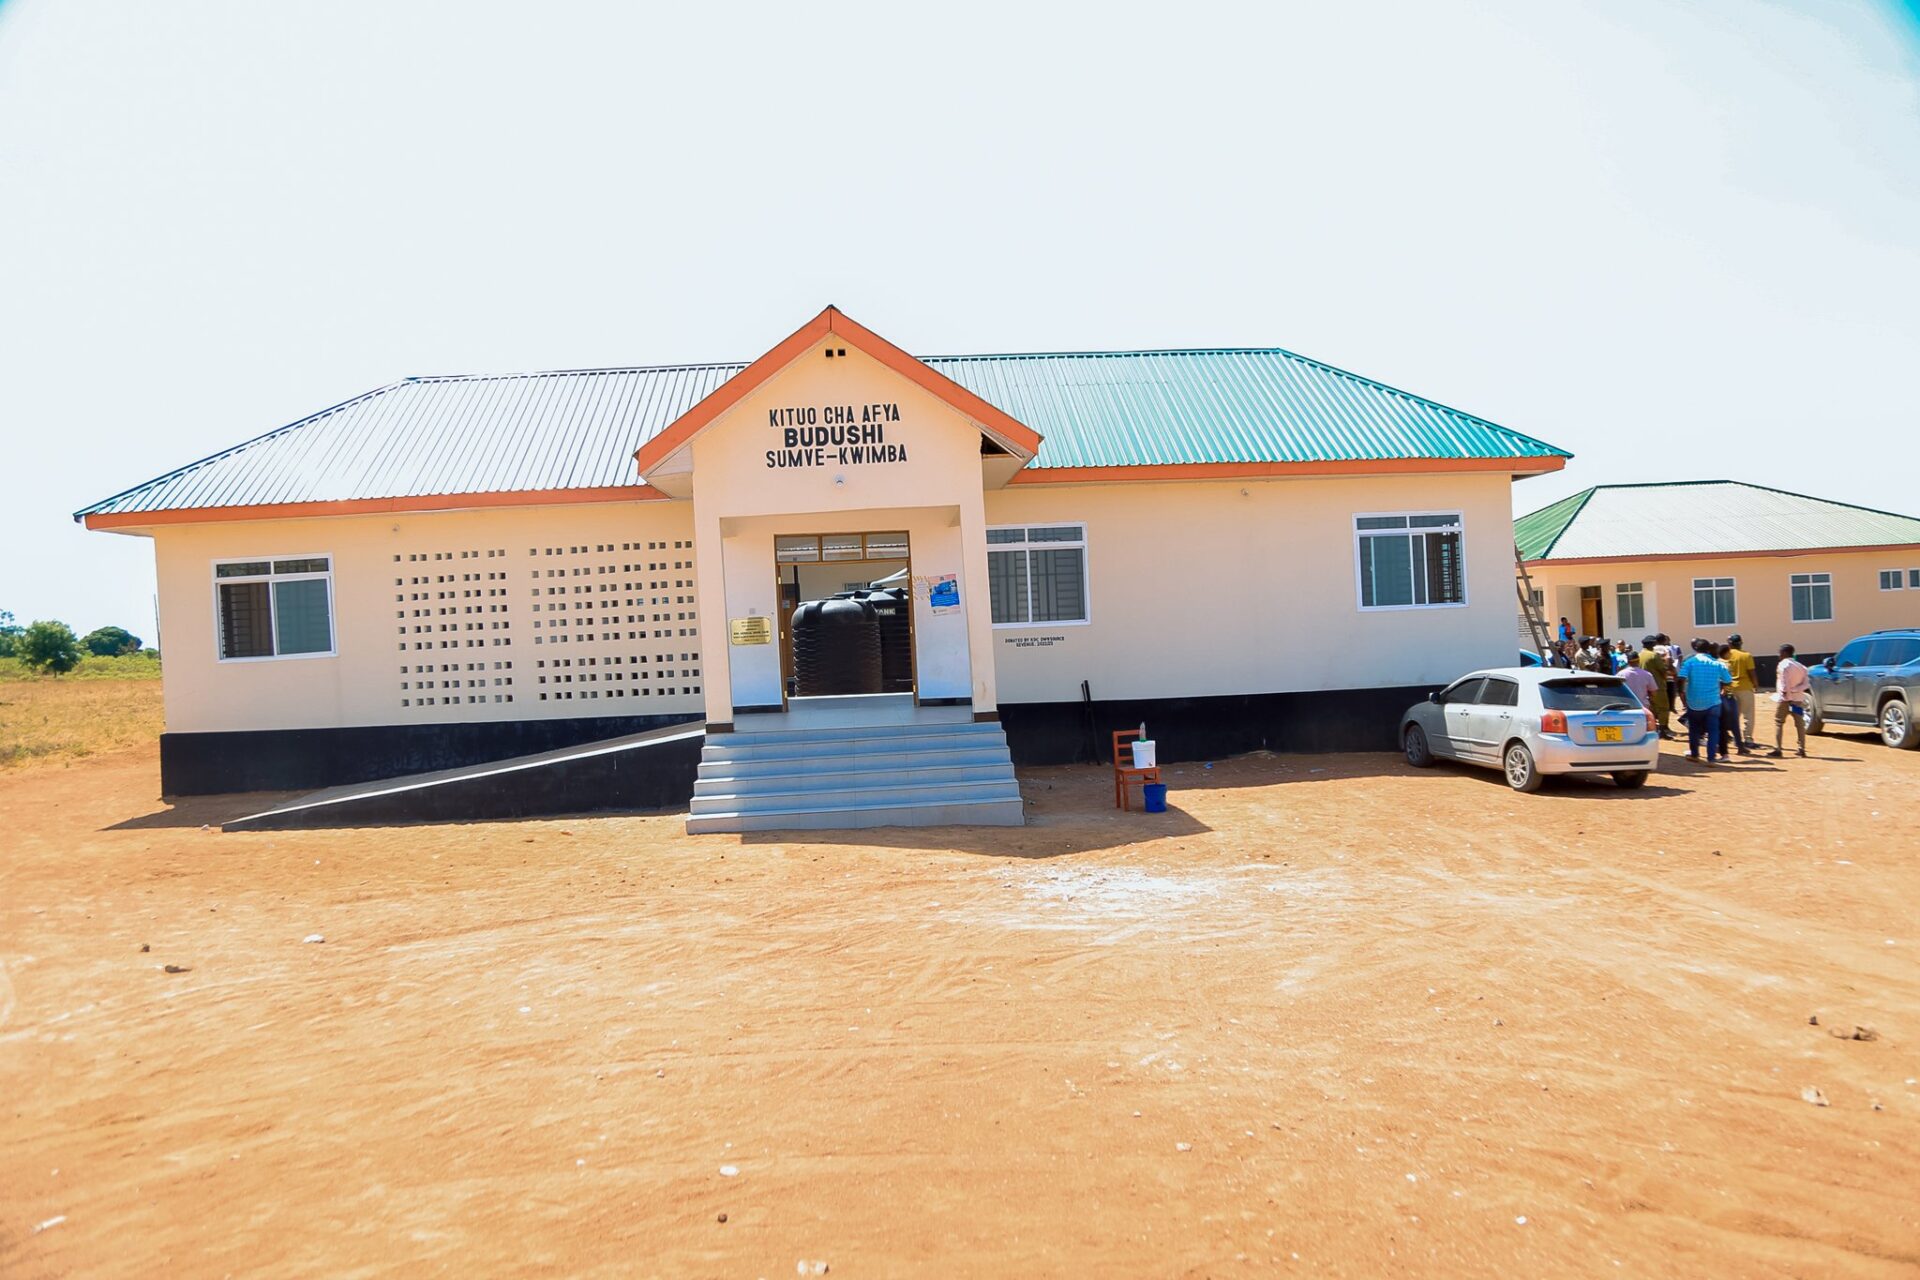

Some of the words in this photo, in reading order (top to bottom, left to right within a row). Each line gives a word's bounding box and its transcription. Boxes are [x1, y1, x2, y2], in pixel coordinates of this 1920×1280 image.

[769, 407, 817, 427] KITUO
[823, 405, 855, 425] CHA
[862, 403, 901, 423] AFYA
[784, 423, 884, 448] BUDUSHI
[765, 444, 908, 469] SUMVE-KWIMBA
